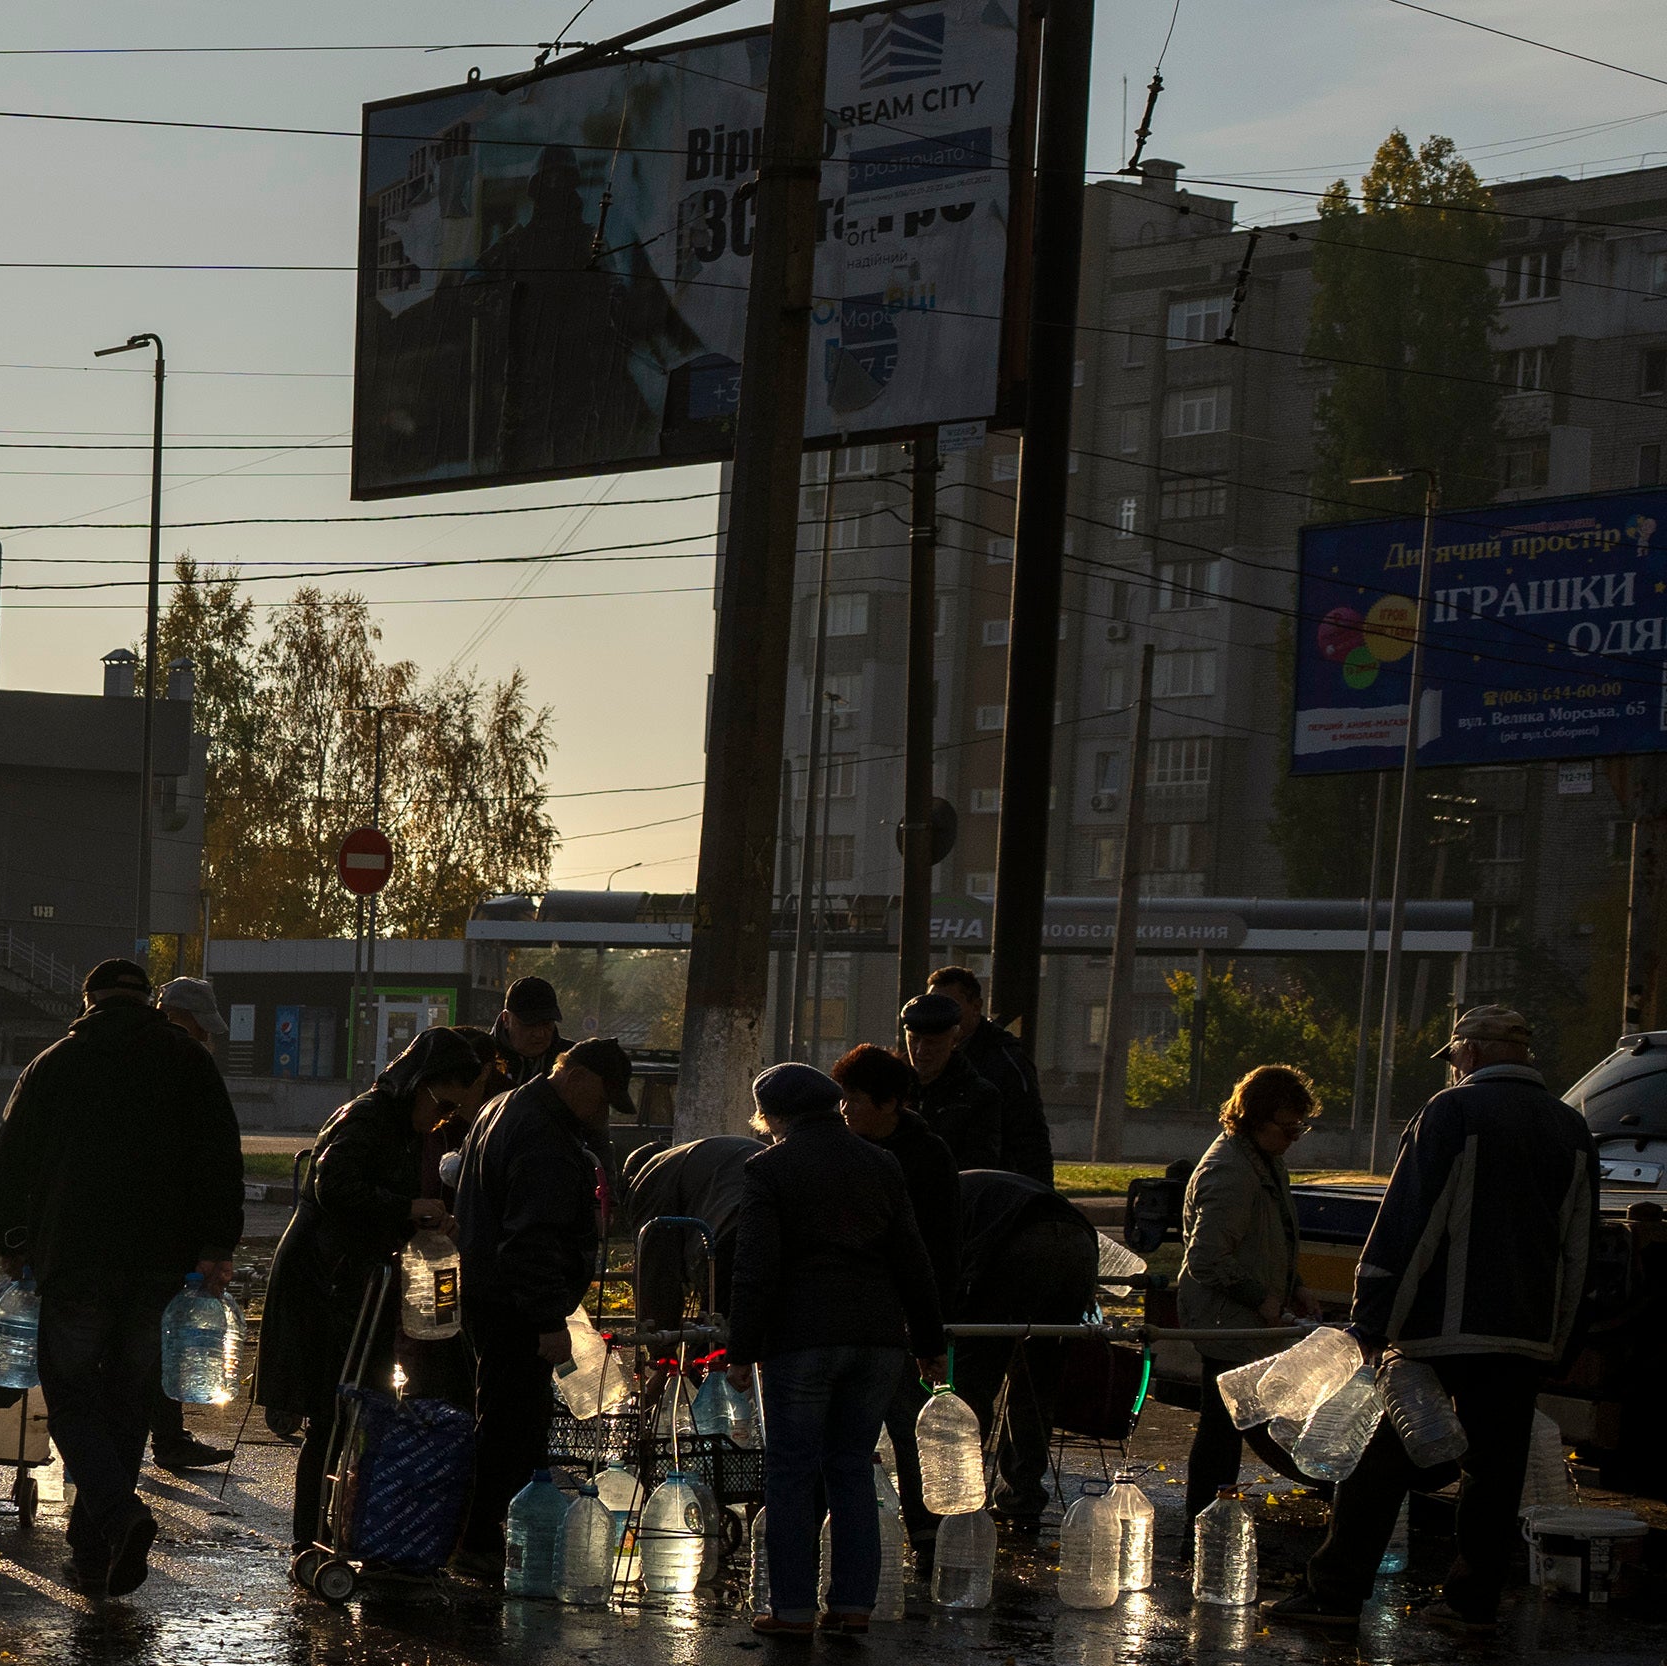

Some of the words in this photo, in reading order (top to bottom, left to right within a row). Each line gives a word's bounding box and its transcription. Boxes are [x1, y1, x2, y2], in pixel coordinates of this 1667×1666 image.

[839, 94, 913, 128] REAM
[922, 80, 985, 112] CITY
[863, 147, 965, 184] розпочато
[692, 189, 757, 262] ЗС
[847, 228, 878, 247] ort
[1383, 531, 1502, 571] Диячий
[1512, 524, 1622, 560] простір
[1433, 572, 1637, 623] ІГРАШКИ
[1568, 616, 1667, 657] ОДЯ
[1542, 681, 1623, 702] 644-60-00
[1458, 714, 1486, 730] вул.
[1492, 709, 1544, 727] Велика
[1549, 705, 1620, 724] Морська,
[1625, 701, 1646, 716] 65
[929, 918, 984, 939] ЕНА
